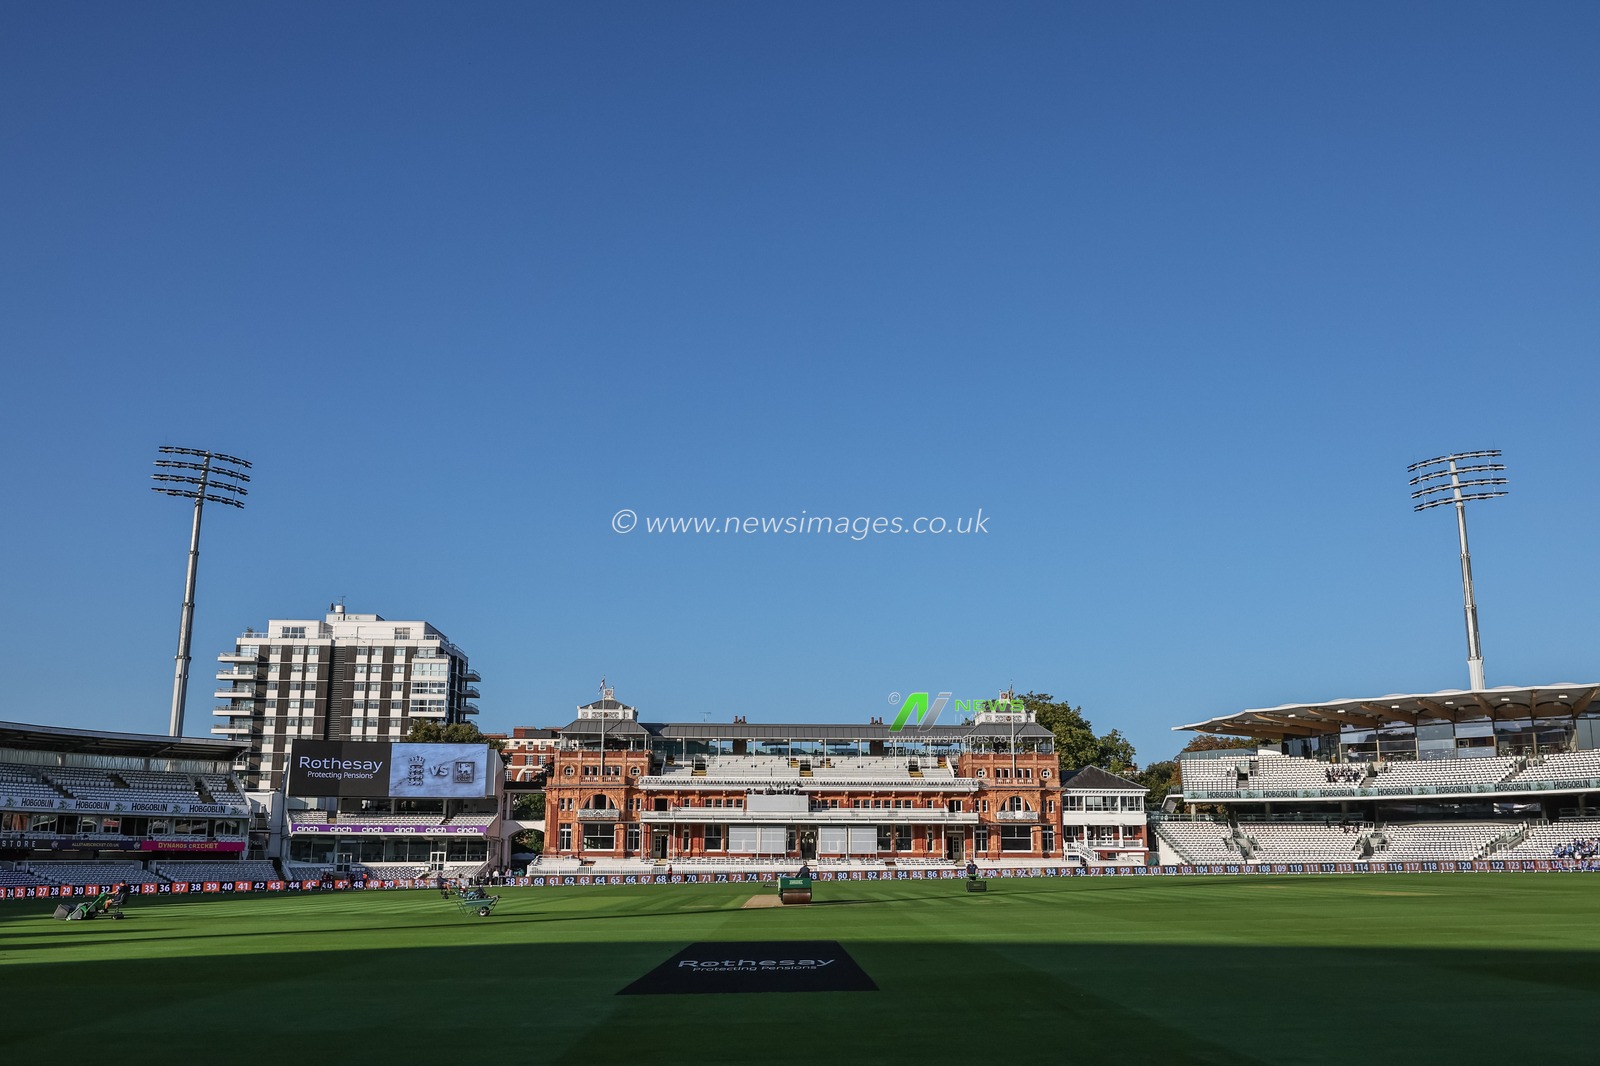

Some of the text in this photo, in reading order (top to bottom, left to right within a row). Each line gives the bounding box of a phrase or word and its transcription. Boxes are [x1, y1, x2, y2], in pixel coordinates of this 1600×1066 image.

[300, 757, 382, 773] Rothesay
[308, 771, 342, 780] Protecting
[22, 798, 225, 813] HOBGOBLIN HOBGOBLIN HOBGOBLIN HOBGOBLIN
[7, 889, 13, 897] 24
[17, 889, 23, 897] 25
[27, 888, 34, 896] 26
[38, 888, 47, 896] 27
[51, 887, 59, 895] 28
[74, 887, 83, 895] 30
[987, 870, 997, 878] 90
[1017, 869, 1027, 877] 92
[1180, 866, 1193, 874] 103
[1242, 865, 1254, 873] 107
[1290, 865, 1302, 873] 110
[1322, 864, 1335, 872] 112
[1441, 862, 1454, 870] 119
[1551, 861, 1563, 869] 126
[678, 959, 835, 967] Rothesay
